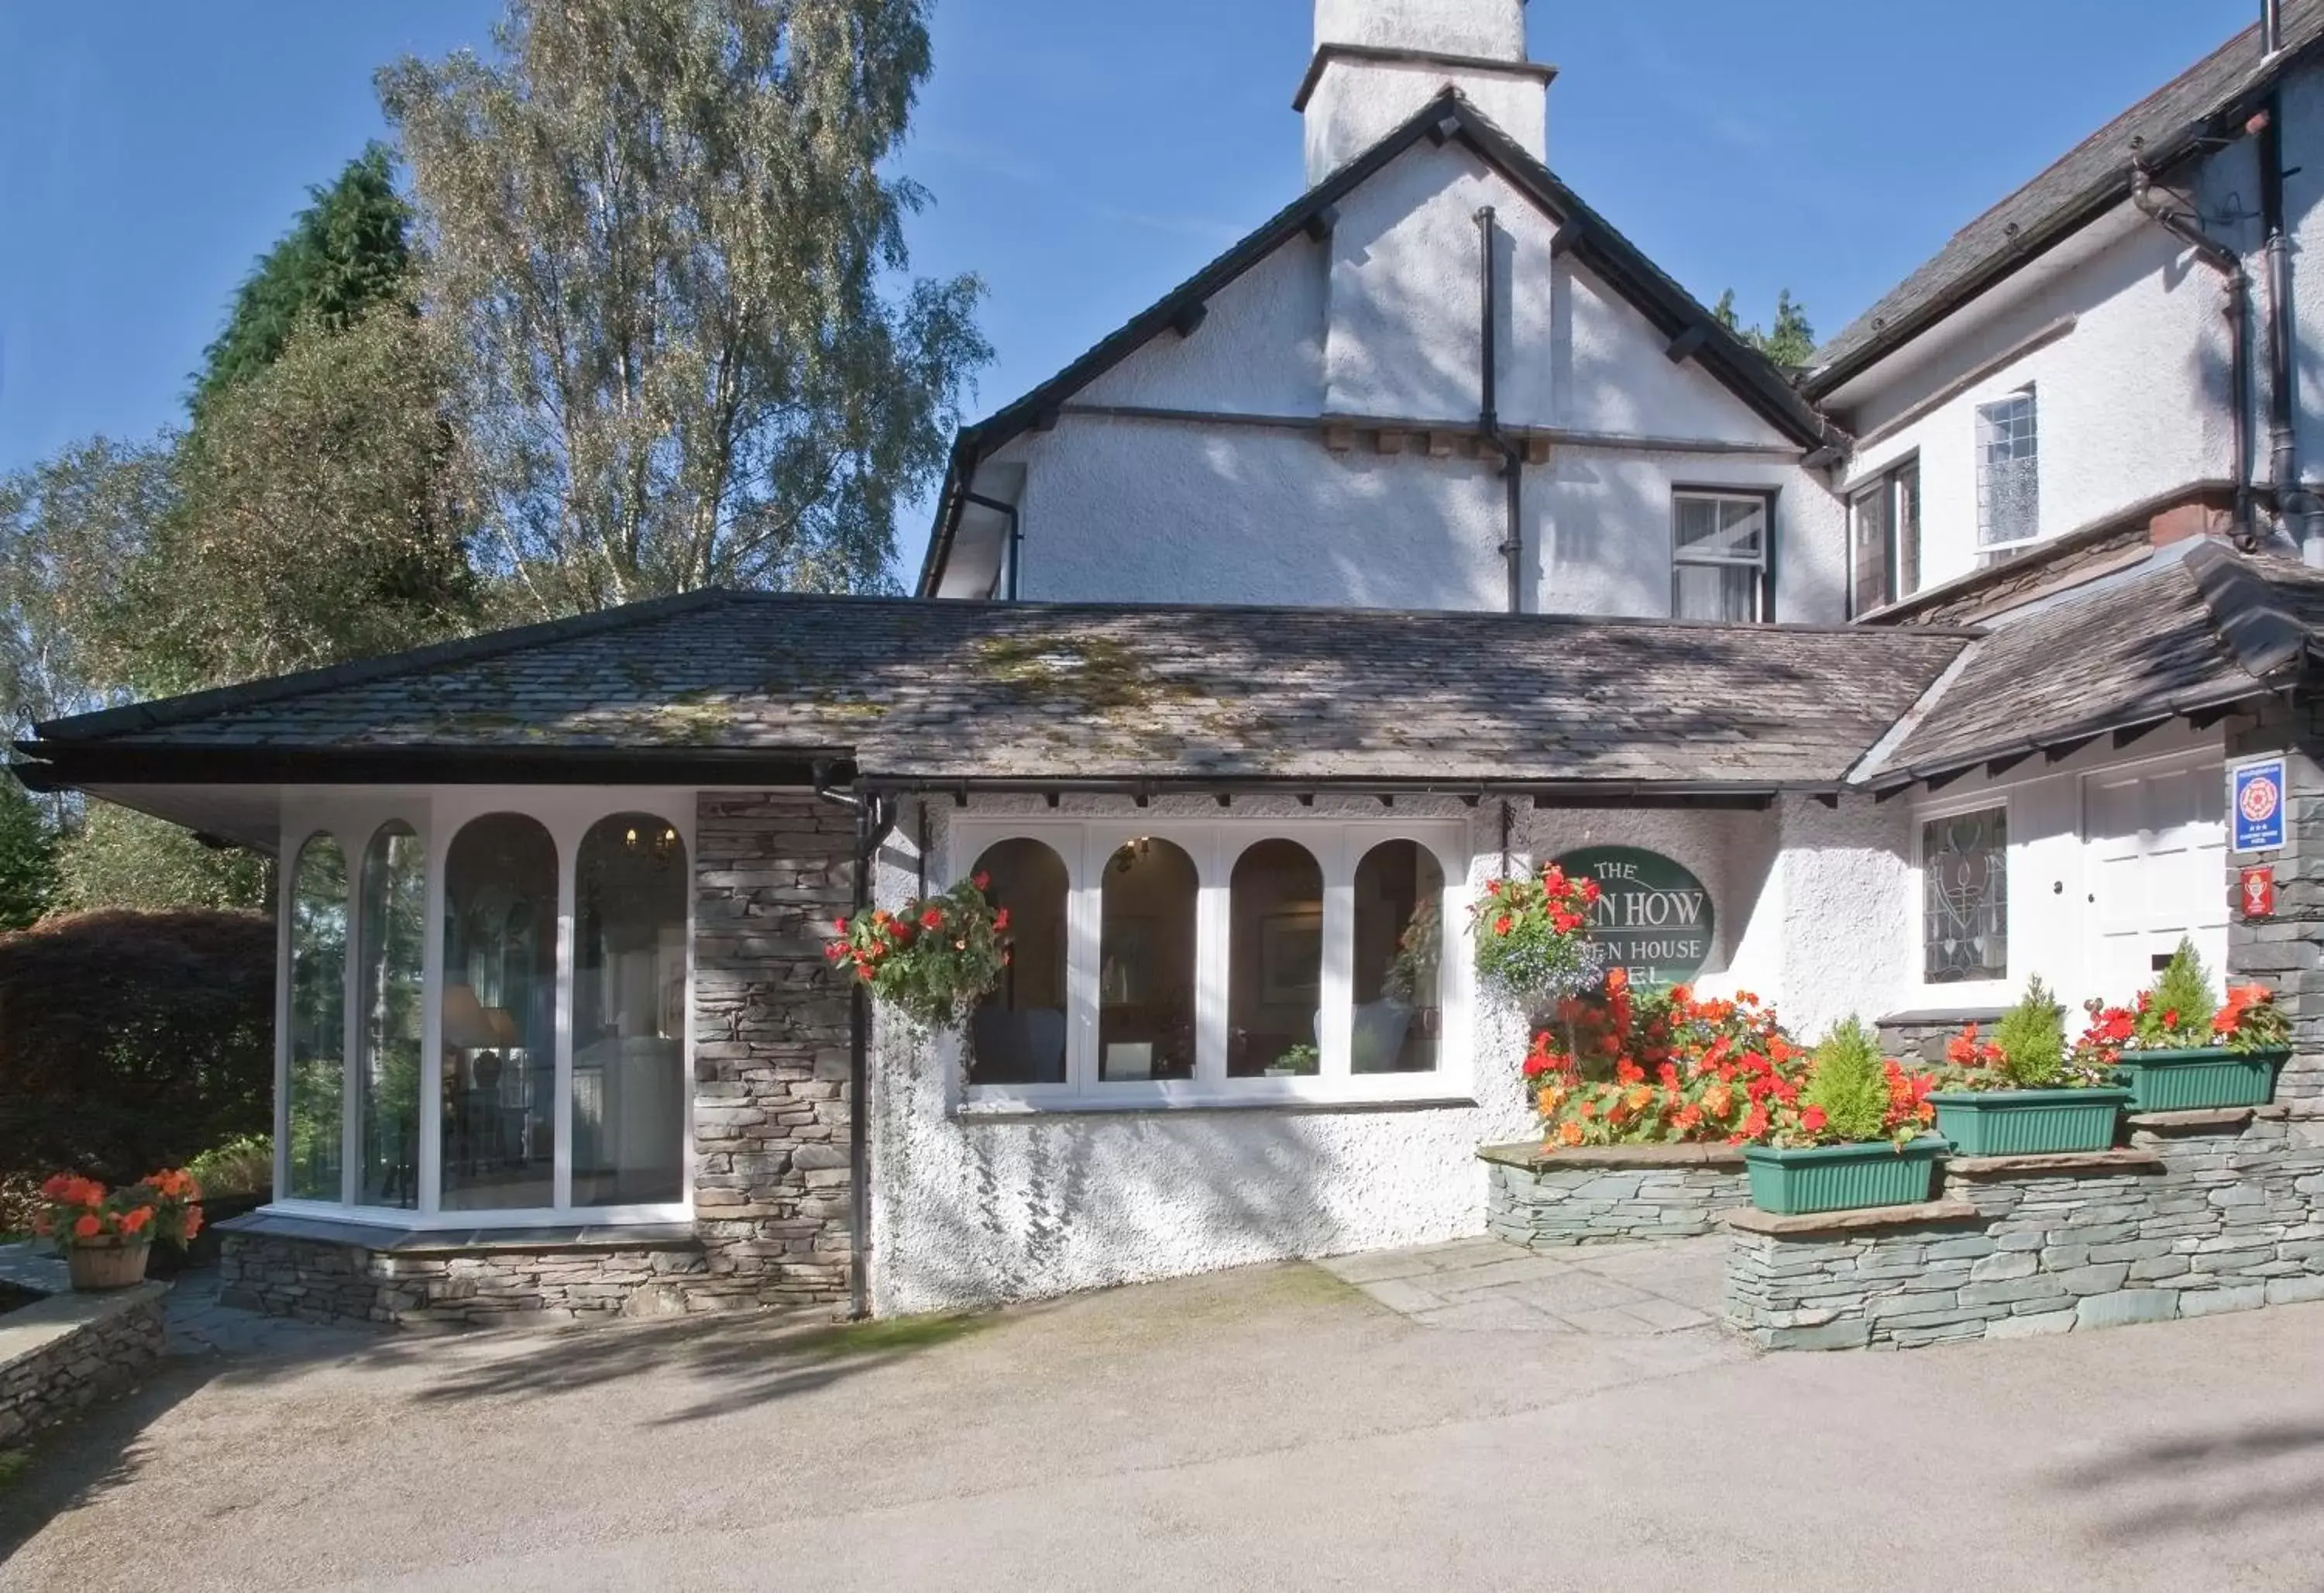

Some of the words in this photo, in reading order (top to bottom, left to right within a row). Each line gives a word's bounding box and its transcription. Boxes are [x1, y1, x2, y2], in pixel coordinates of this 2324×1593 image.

[1593, 861, 1638, 879] THE
[1624, 892, 1703, 926] HOW
[1631, 940, 1702, 959] HOUSE
